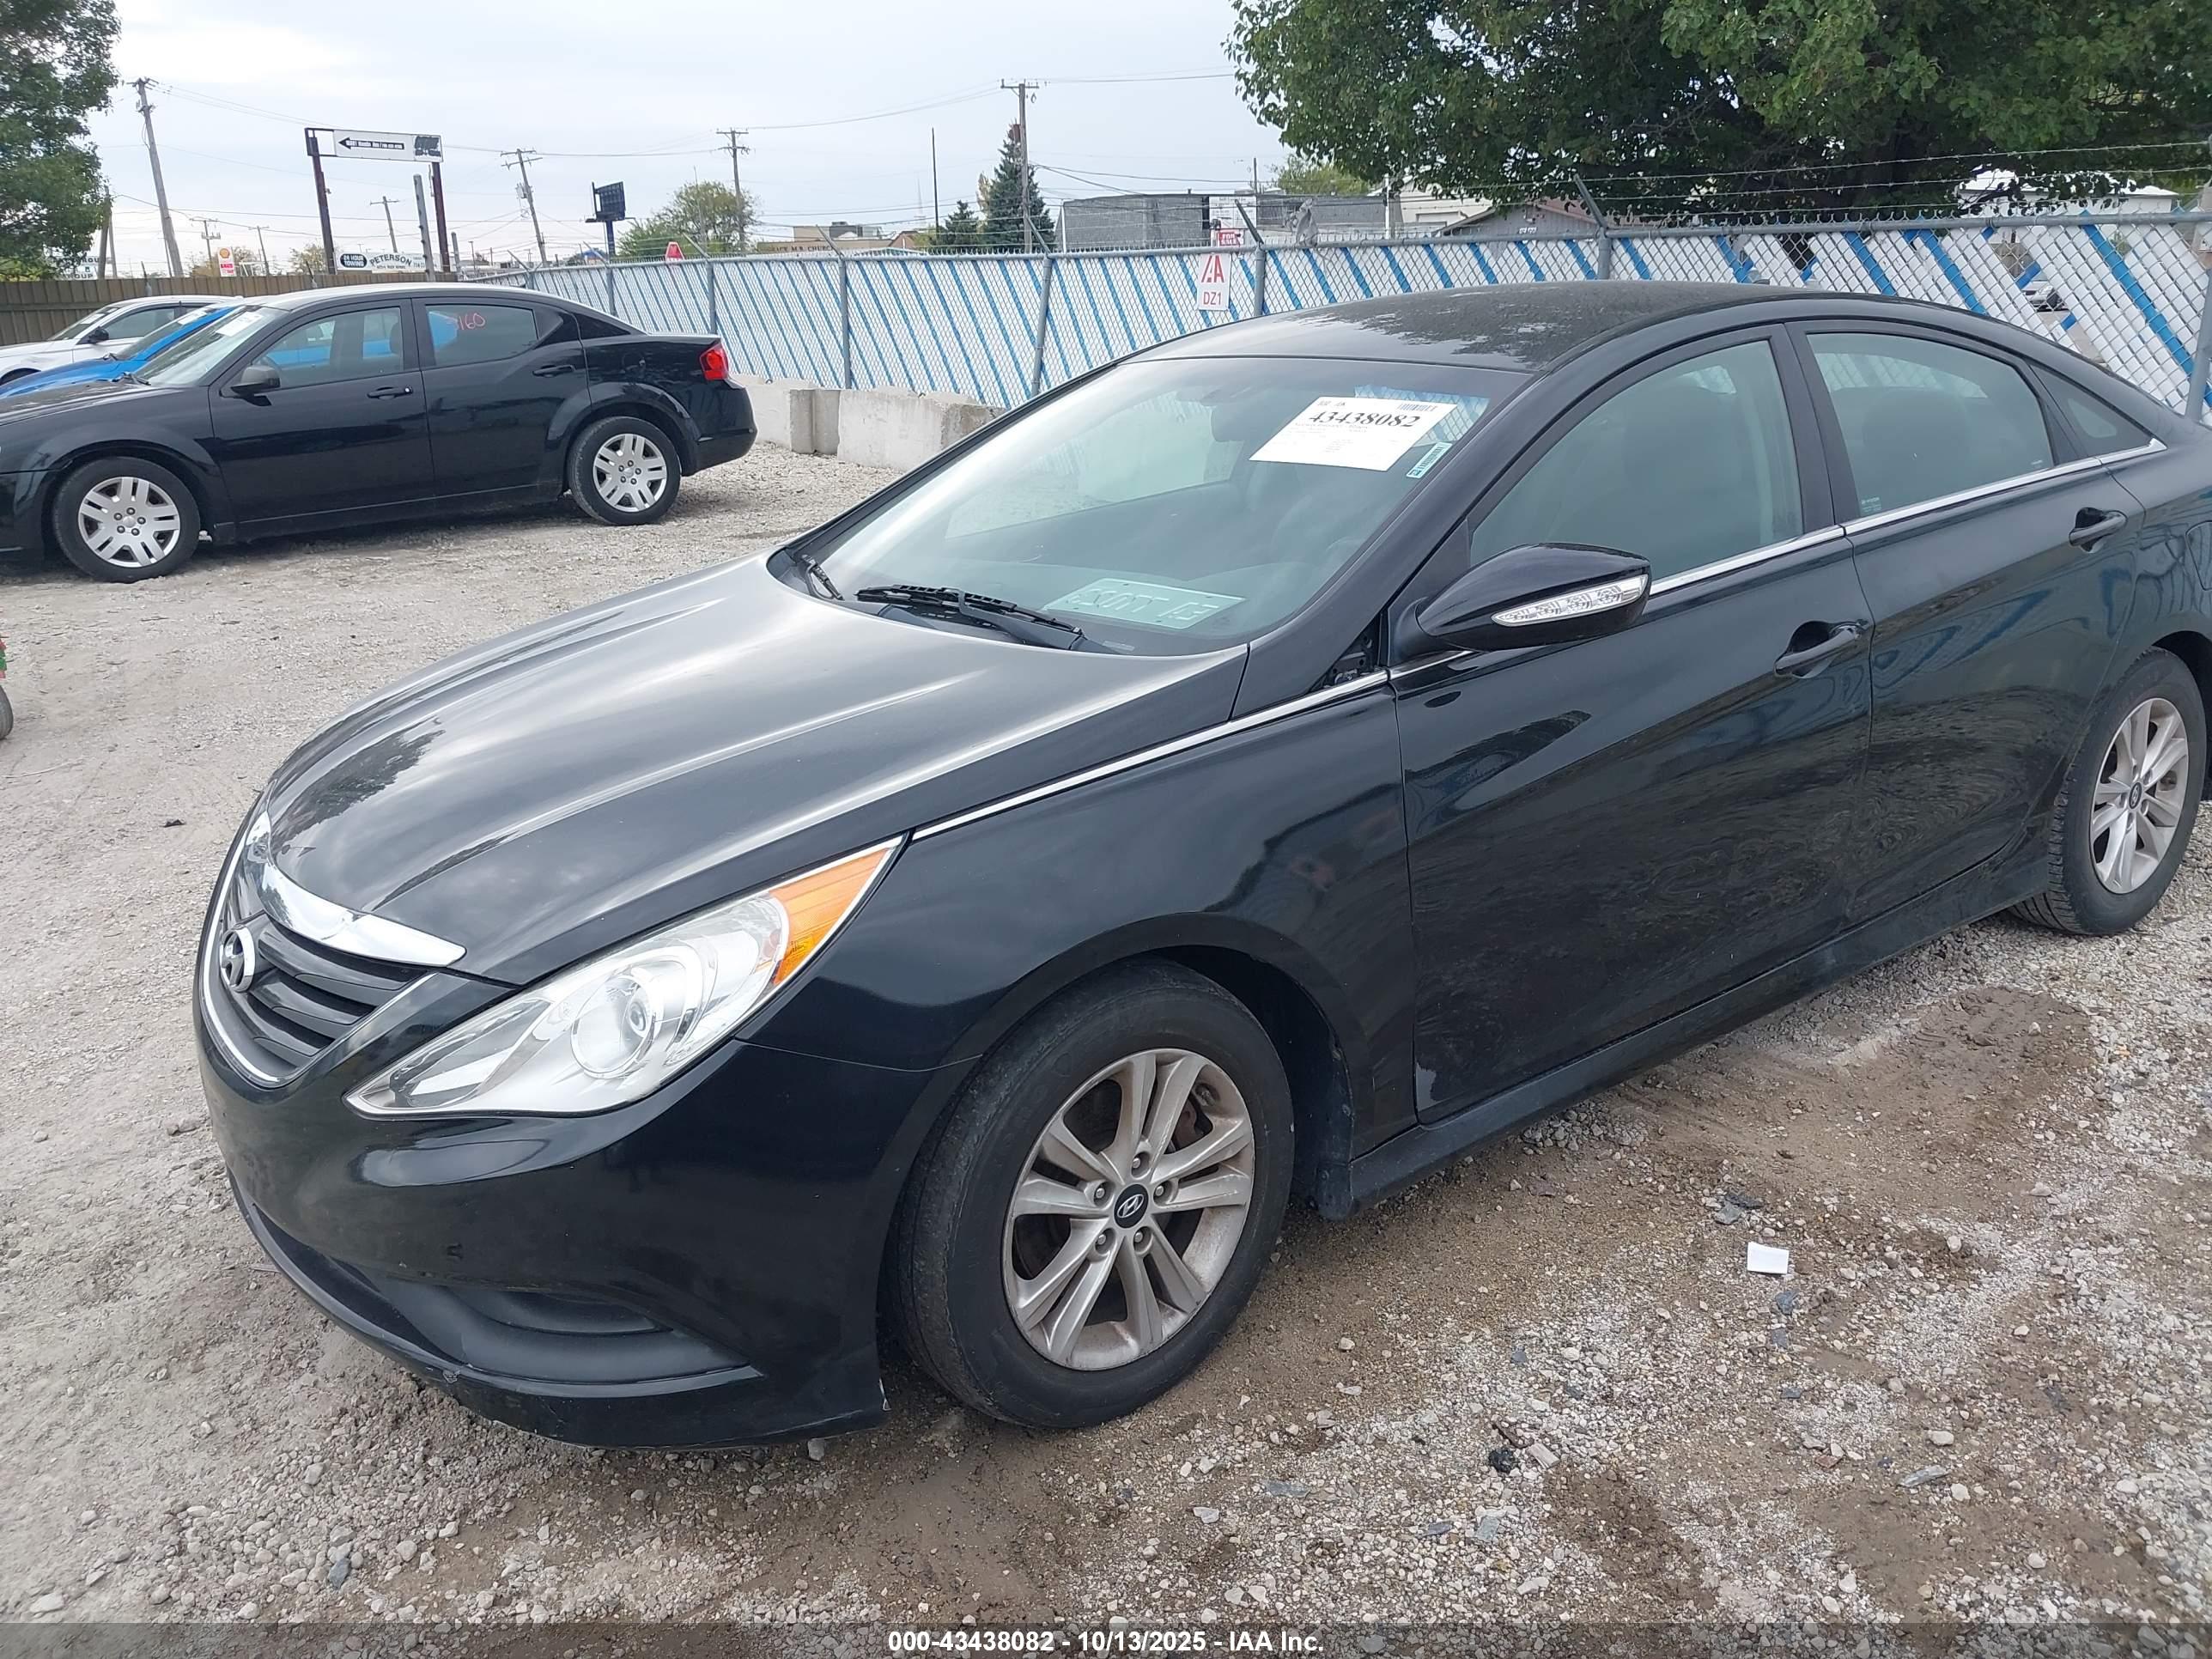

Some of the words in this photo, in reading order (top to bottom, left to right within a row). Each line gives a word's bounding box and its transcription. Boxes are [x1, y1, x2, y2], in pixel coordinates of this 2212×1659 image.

[369, 254, 412, 266] PETERSON
[1204, 291, 1222, 306] DZ1
[1308, 410, 1421, 428] 43438082
